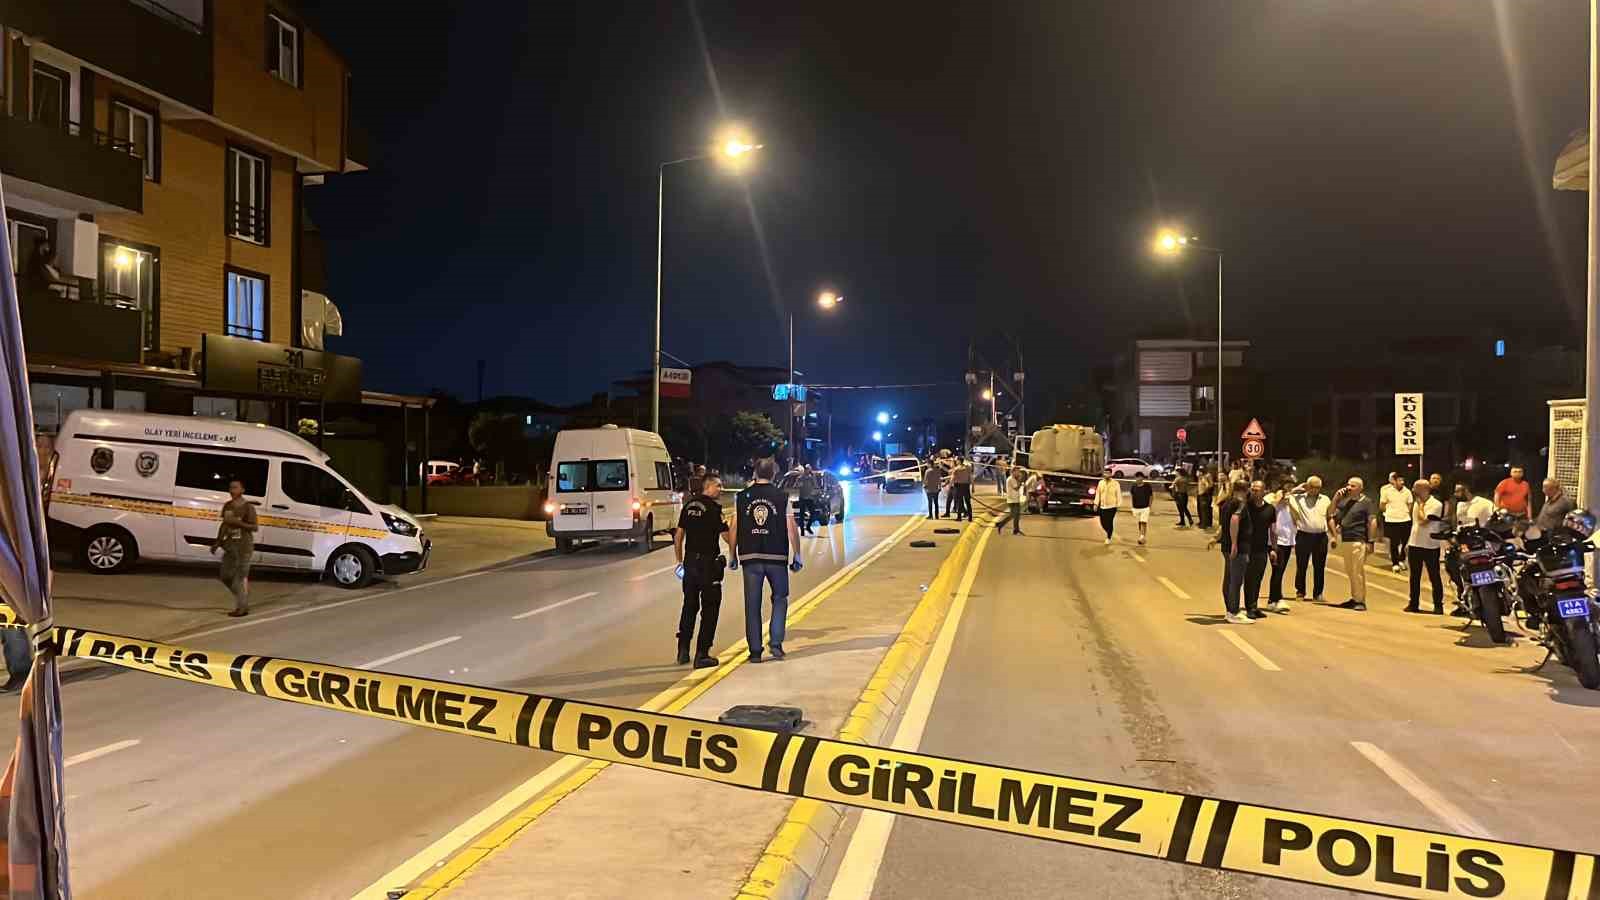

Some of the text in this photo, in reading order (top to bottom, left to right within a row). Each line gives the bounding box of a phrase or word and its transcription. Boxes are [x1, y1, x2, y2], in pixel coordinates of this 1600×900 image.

[1402, 396, 1417, 446] KUAFÖR
[1247, 443, 1260, 453] 30
[1574, 600, 1582, 608] A
